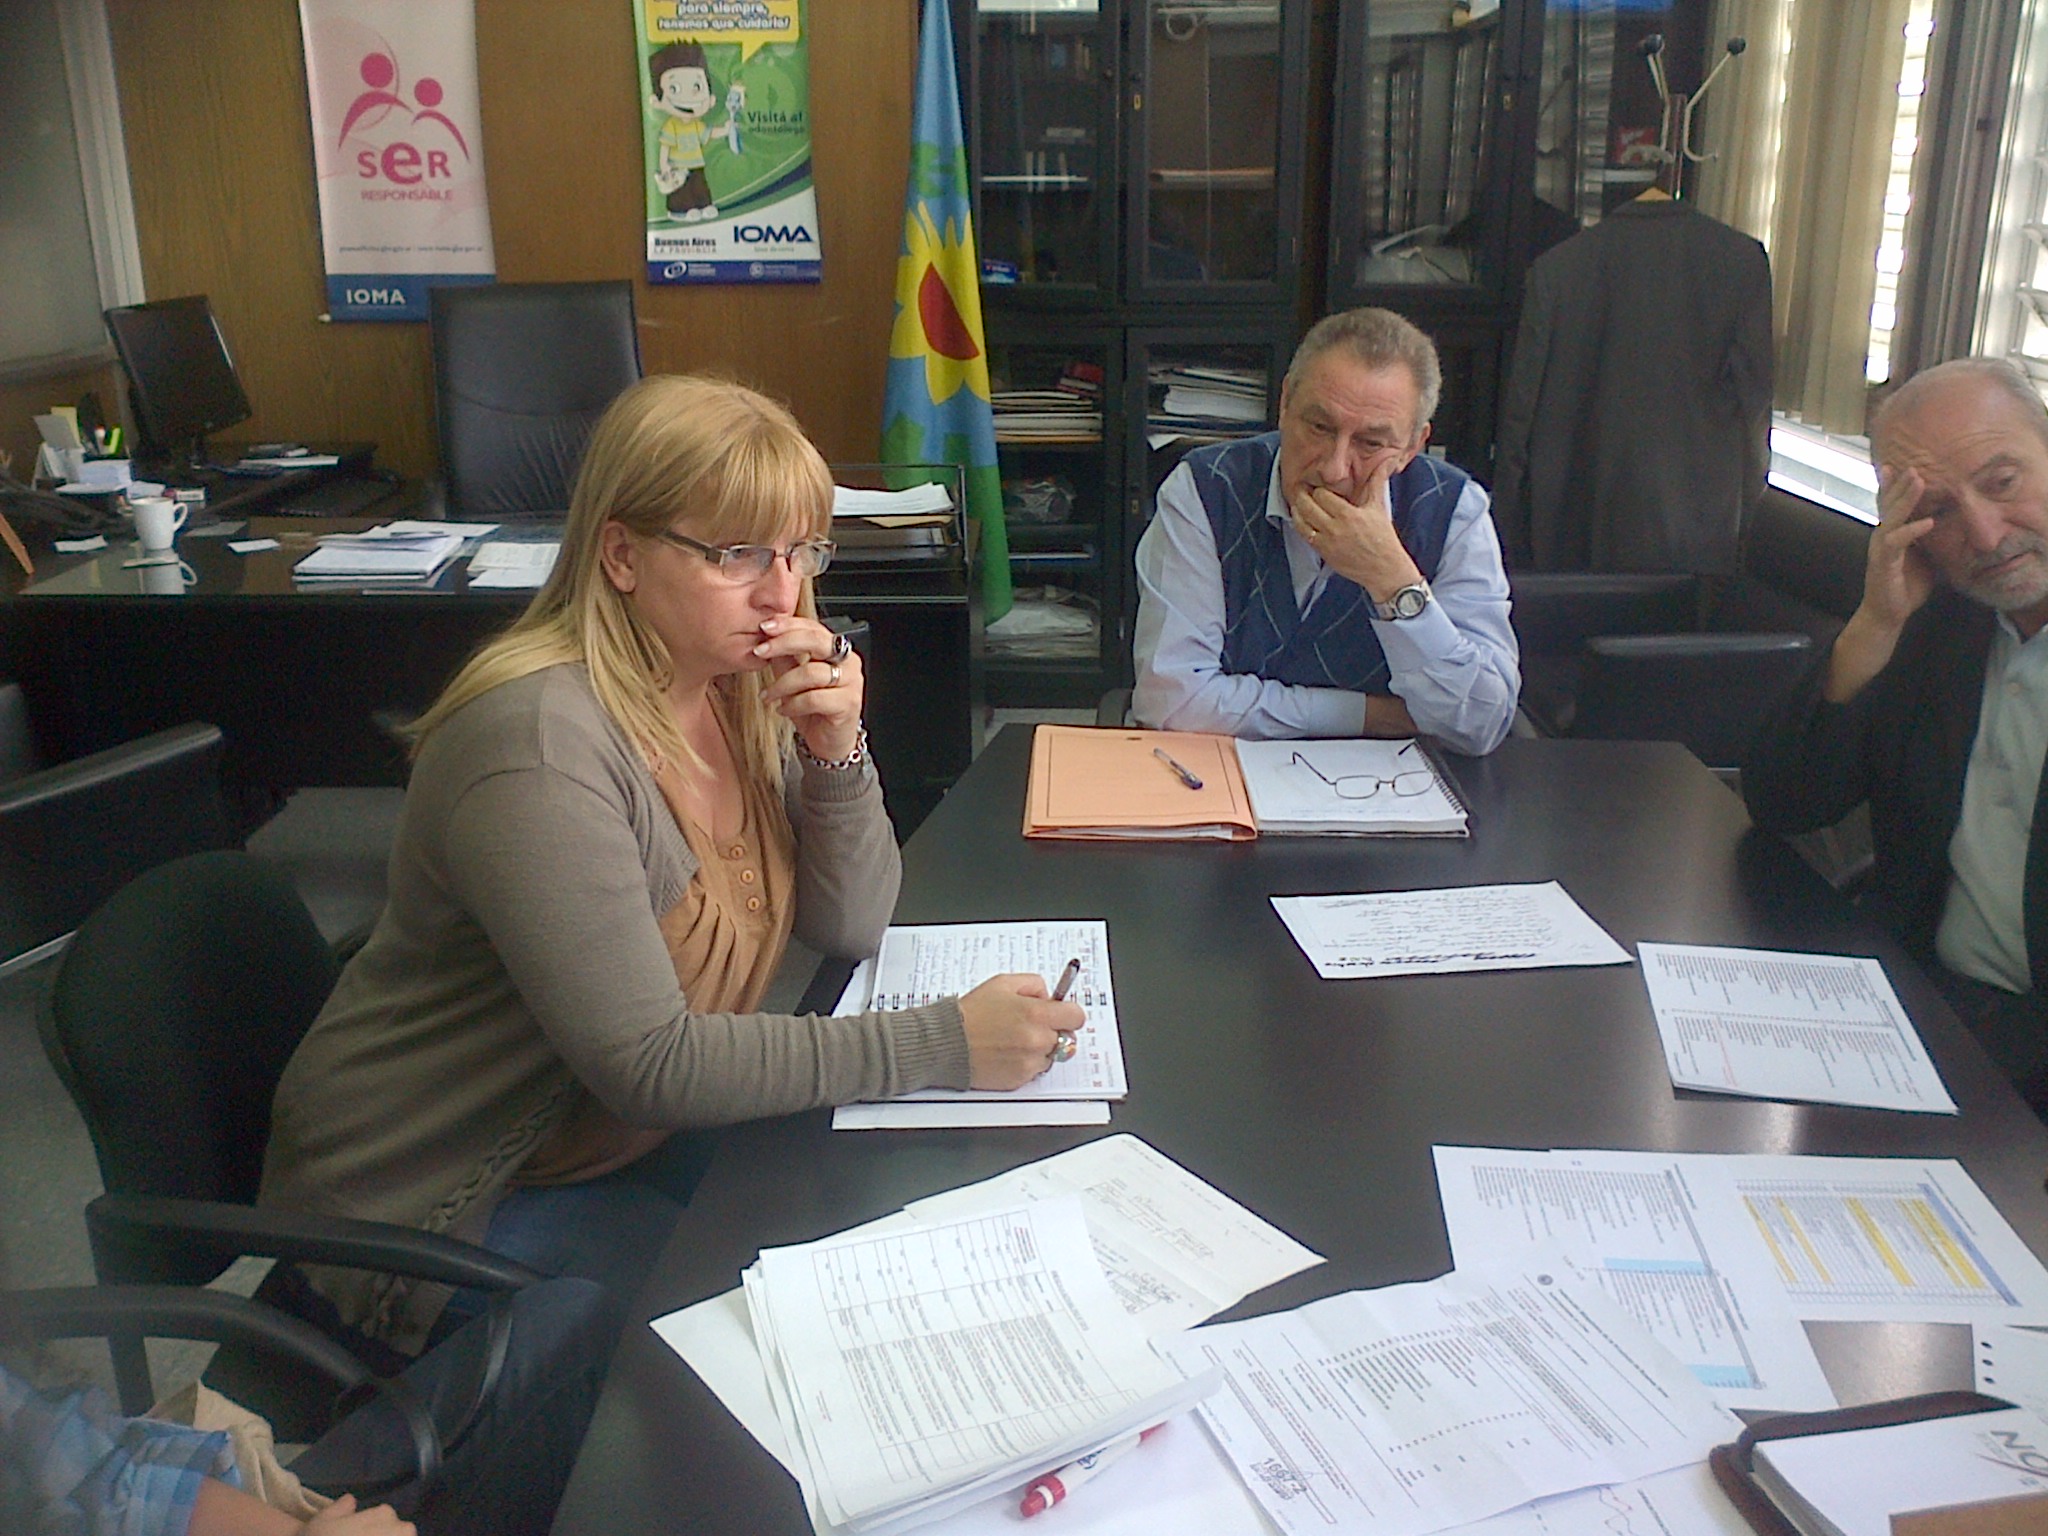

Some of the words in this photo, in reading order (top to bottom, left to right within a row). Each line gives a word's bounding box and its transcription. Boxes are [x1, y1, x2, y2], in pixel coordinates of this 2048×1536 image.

[711, 18, 735, 31] que
[360, 189, 454, 201] RESPONSABLE
[733, 225, 814, 243] IOMA
[654, 237, 690, 247] Buenos
[691, 237, 717, 247] Aires
[346, 288, 407, 305] IOMA
